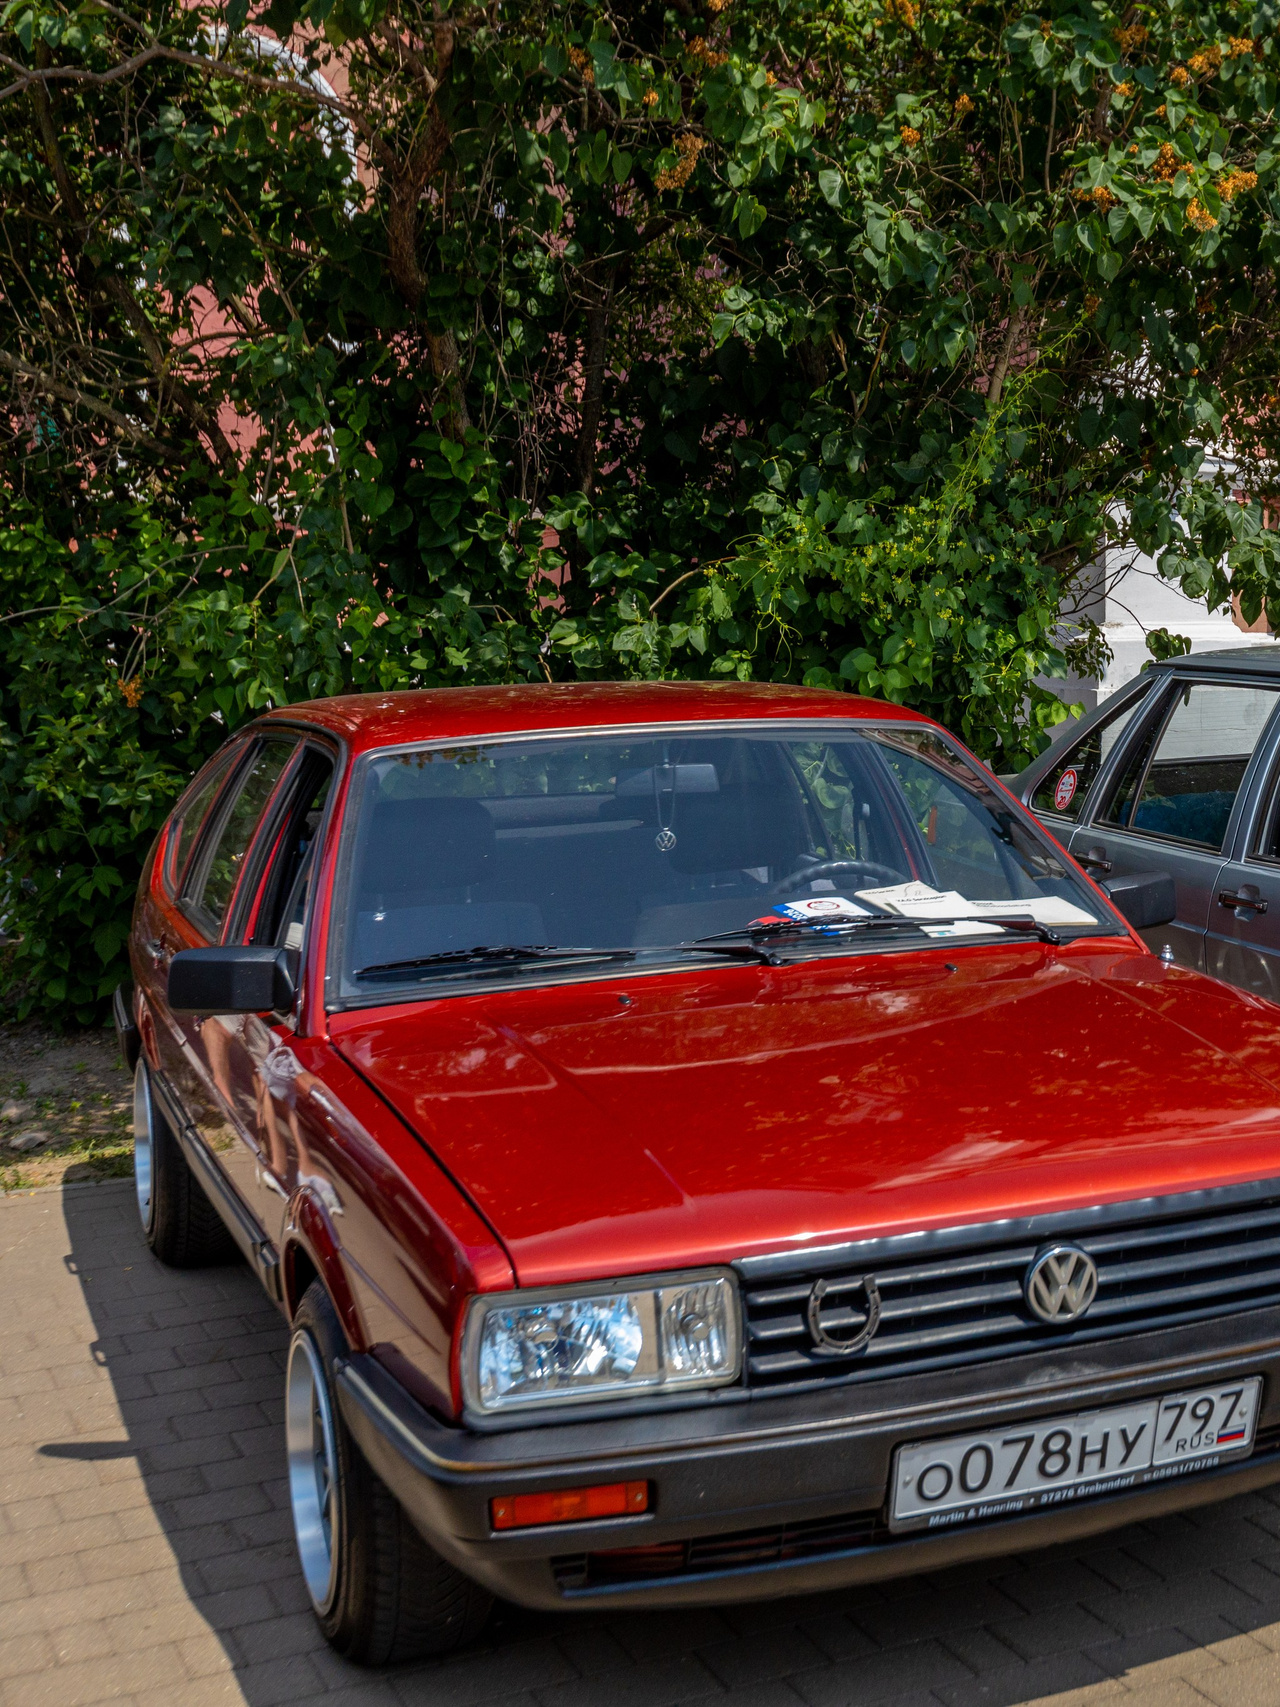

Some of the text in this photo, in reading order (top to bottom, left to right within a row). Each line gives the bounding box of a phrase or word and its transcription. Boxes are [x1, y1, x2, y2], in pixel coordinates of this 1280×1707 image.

[1163, 1389, 1244, 1442] 797
[1175, 1431, 1215, 1453] RUS
[928, 1509, 965, 1527] Martin
[1076, 1474, 1136, 1497] Grebendorf
